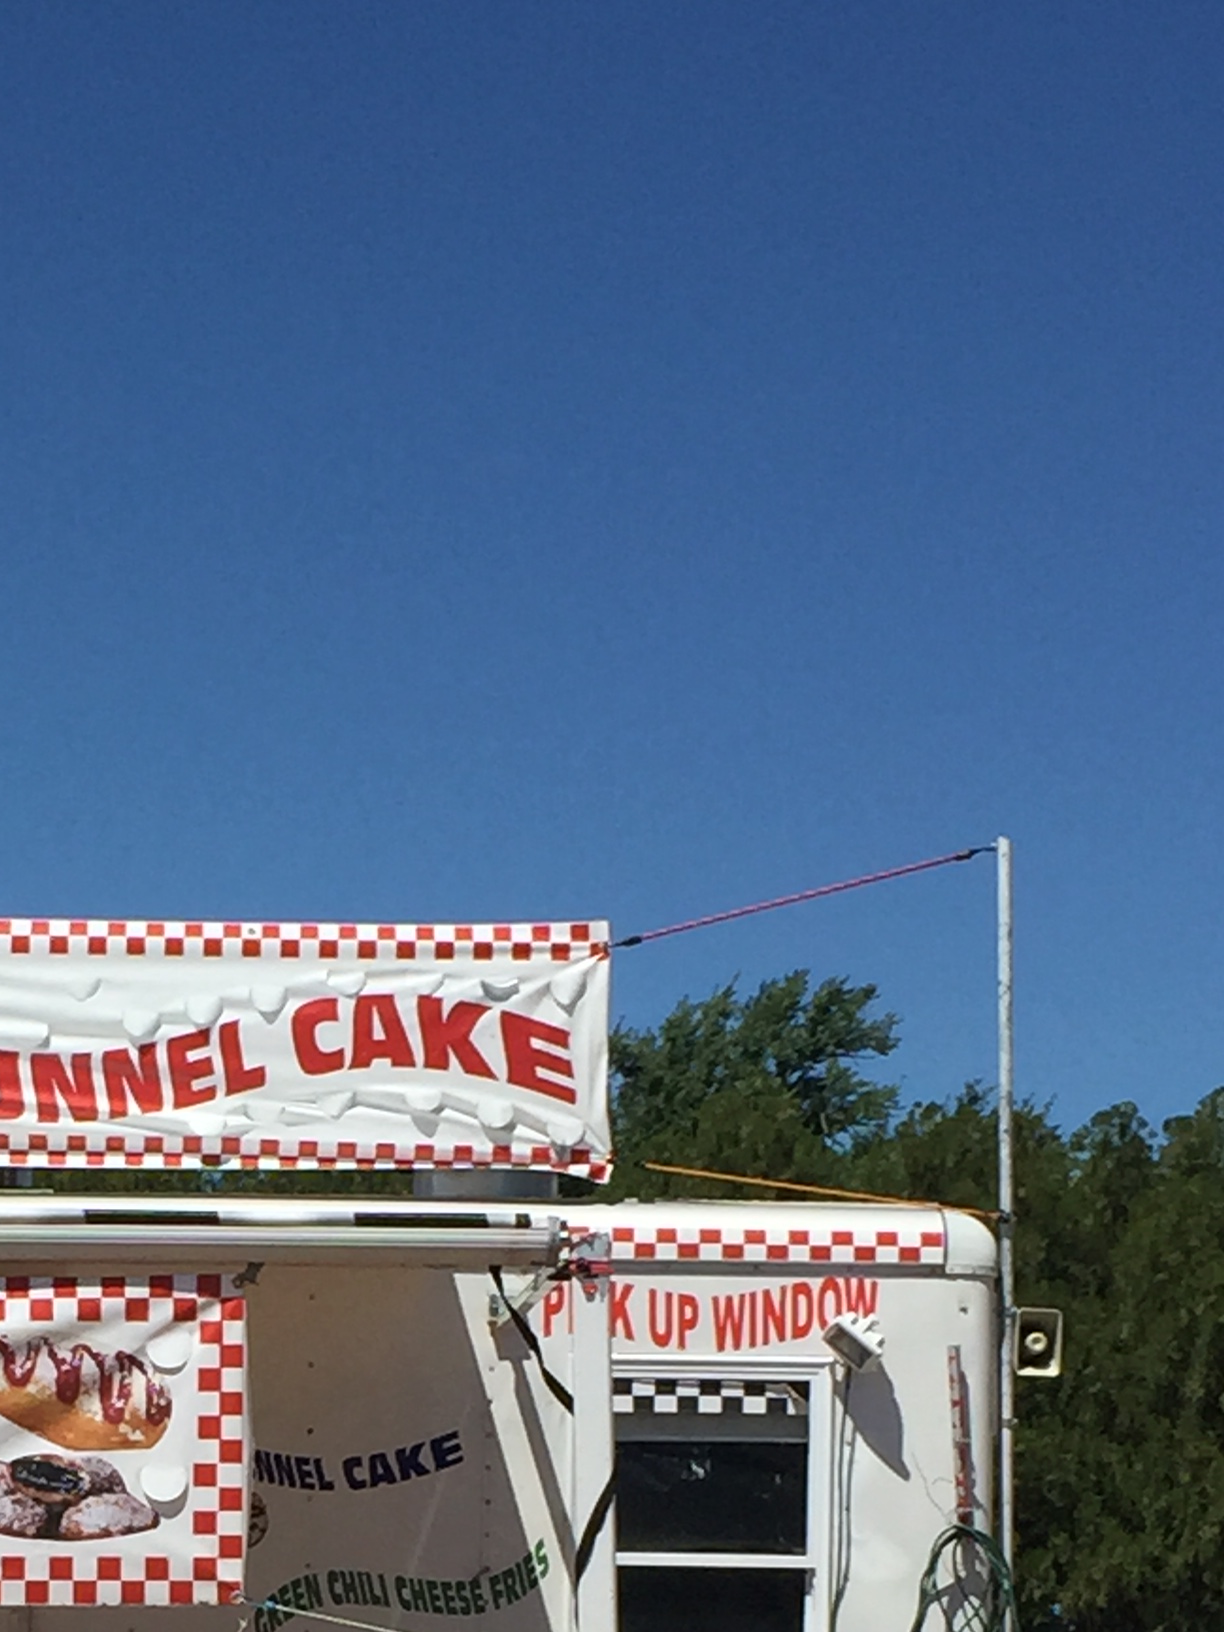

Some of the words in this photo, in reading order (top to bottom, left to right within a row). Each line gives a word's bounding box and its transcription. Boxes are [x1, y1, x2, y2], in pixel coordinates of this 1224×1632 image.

[290, 994, 577, 1104] CAKE
[543, 1280, 634, 1341] PIK
[649, 1287, 699, 1351] UP
[711, 1276, 879, 1353] WINDOW
[254, 1448, 335, 1491] NNEL
[342, 1430, 464, 1491] CAKE
[326, 1569, 391, 1608] CHILI
[395, 1575, 487, 1616] CHEESE
[489, 1538, 550, 1610] FRIES
